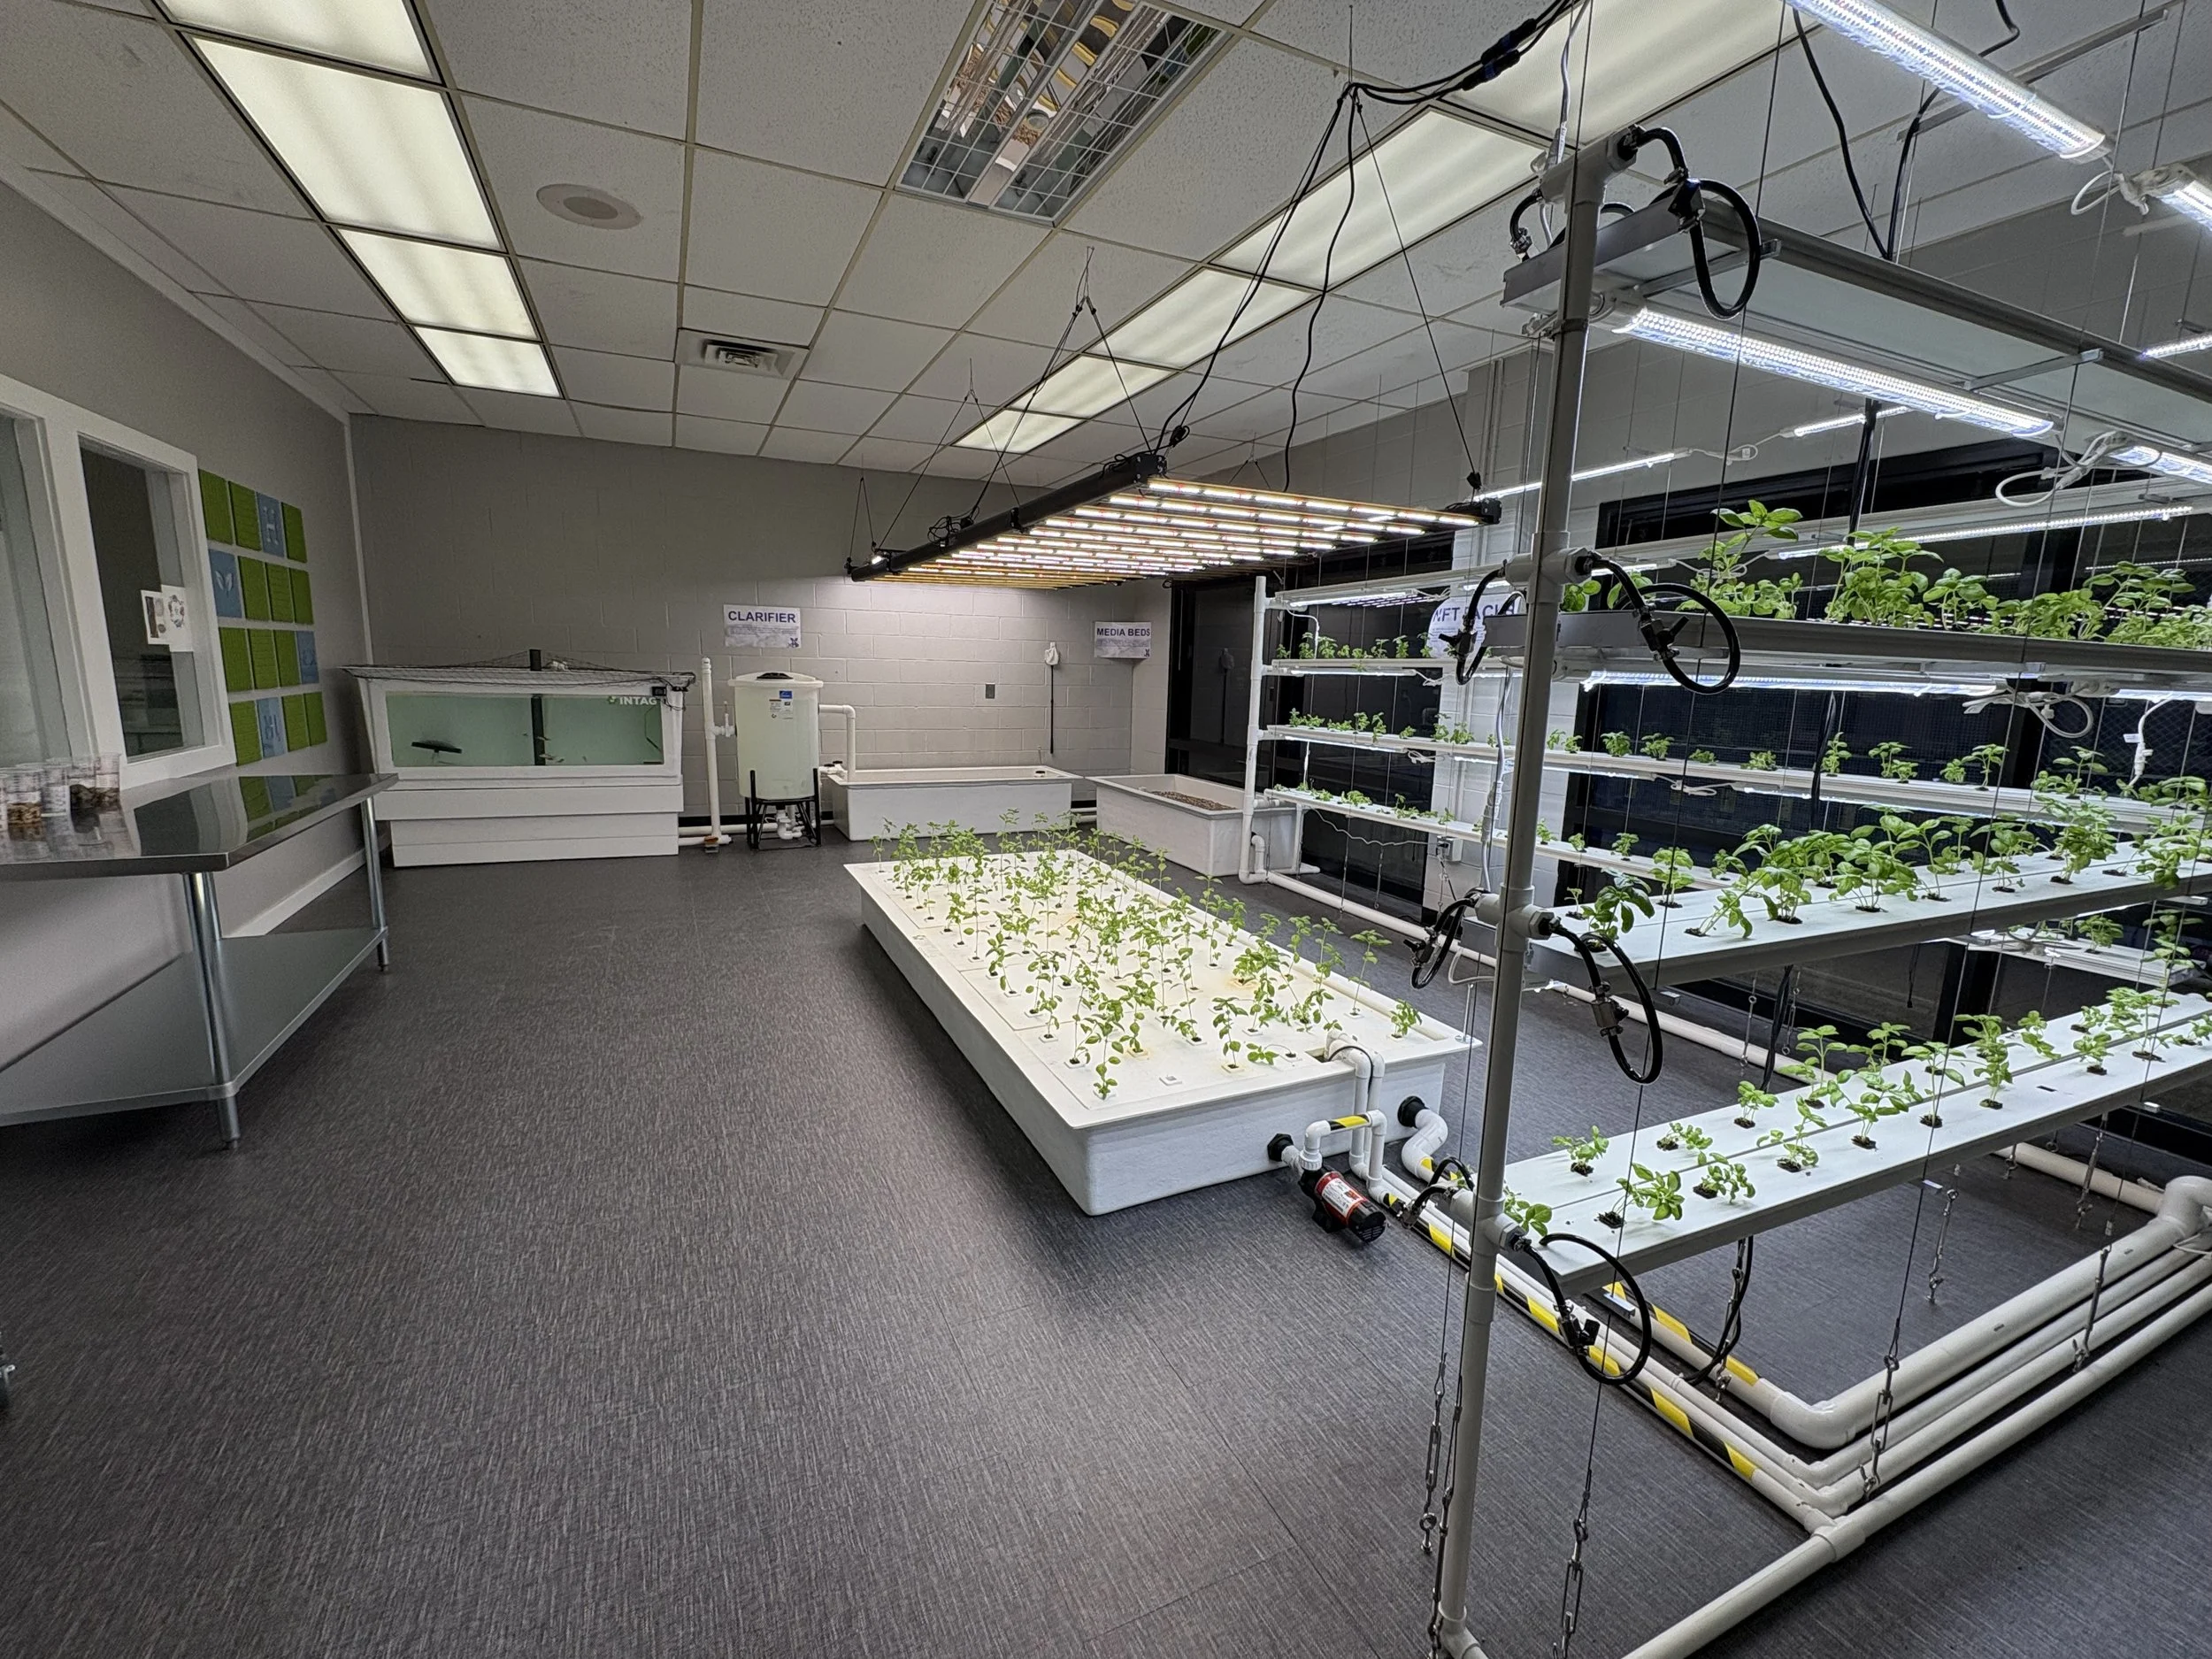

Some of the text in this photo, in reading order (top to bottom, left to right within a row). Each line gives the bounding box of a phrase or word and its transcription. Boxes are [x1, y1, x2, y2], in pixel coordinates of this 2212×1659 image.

[728, 611, 796, 624] CLARIFIER
[1432, 607, 1461, 623] NFT
[1096, 627, 1125, 636] MEDIA
[619, 696, 657, 705] INTAG
